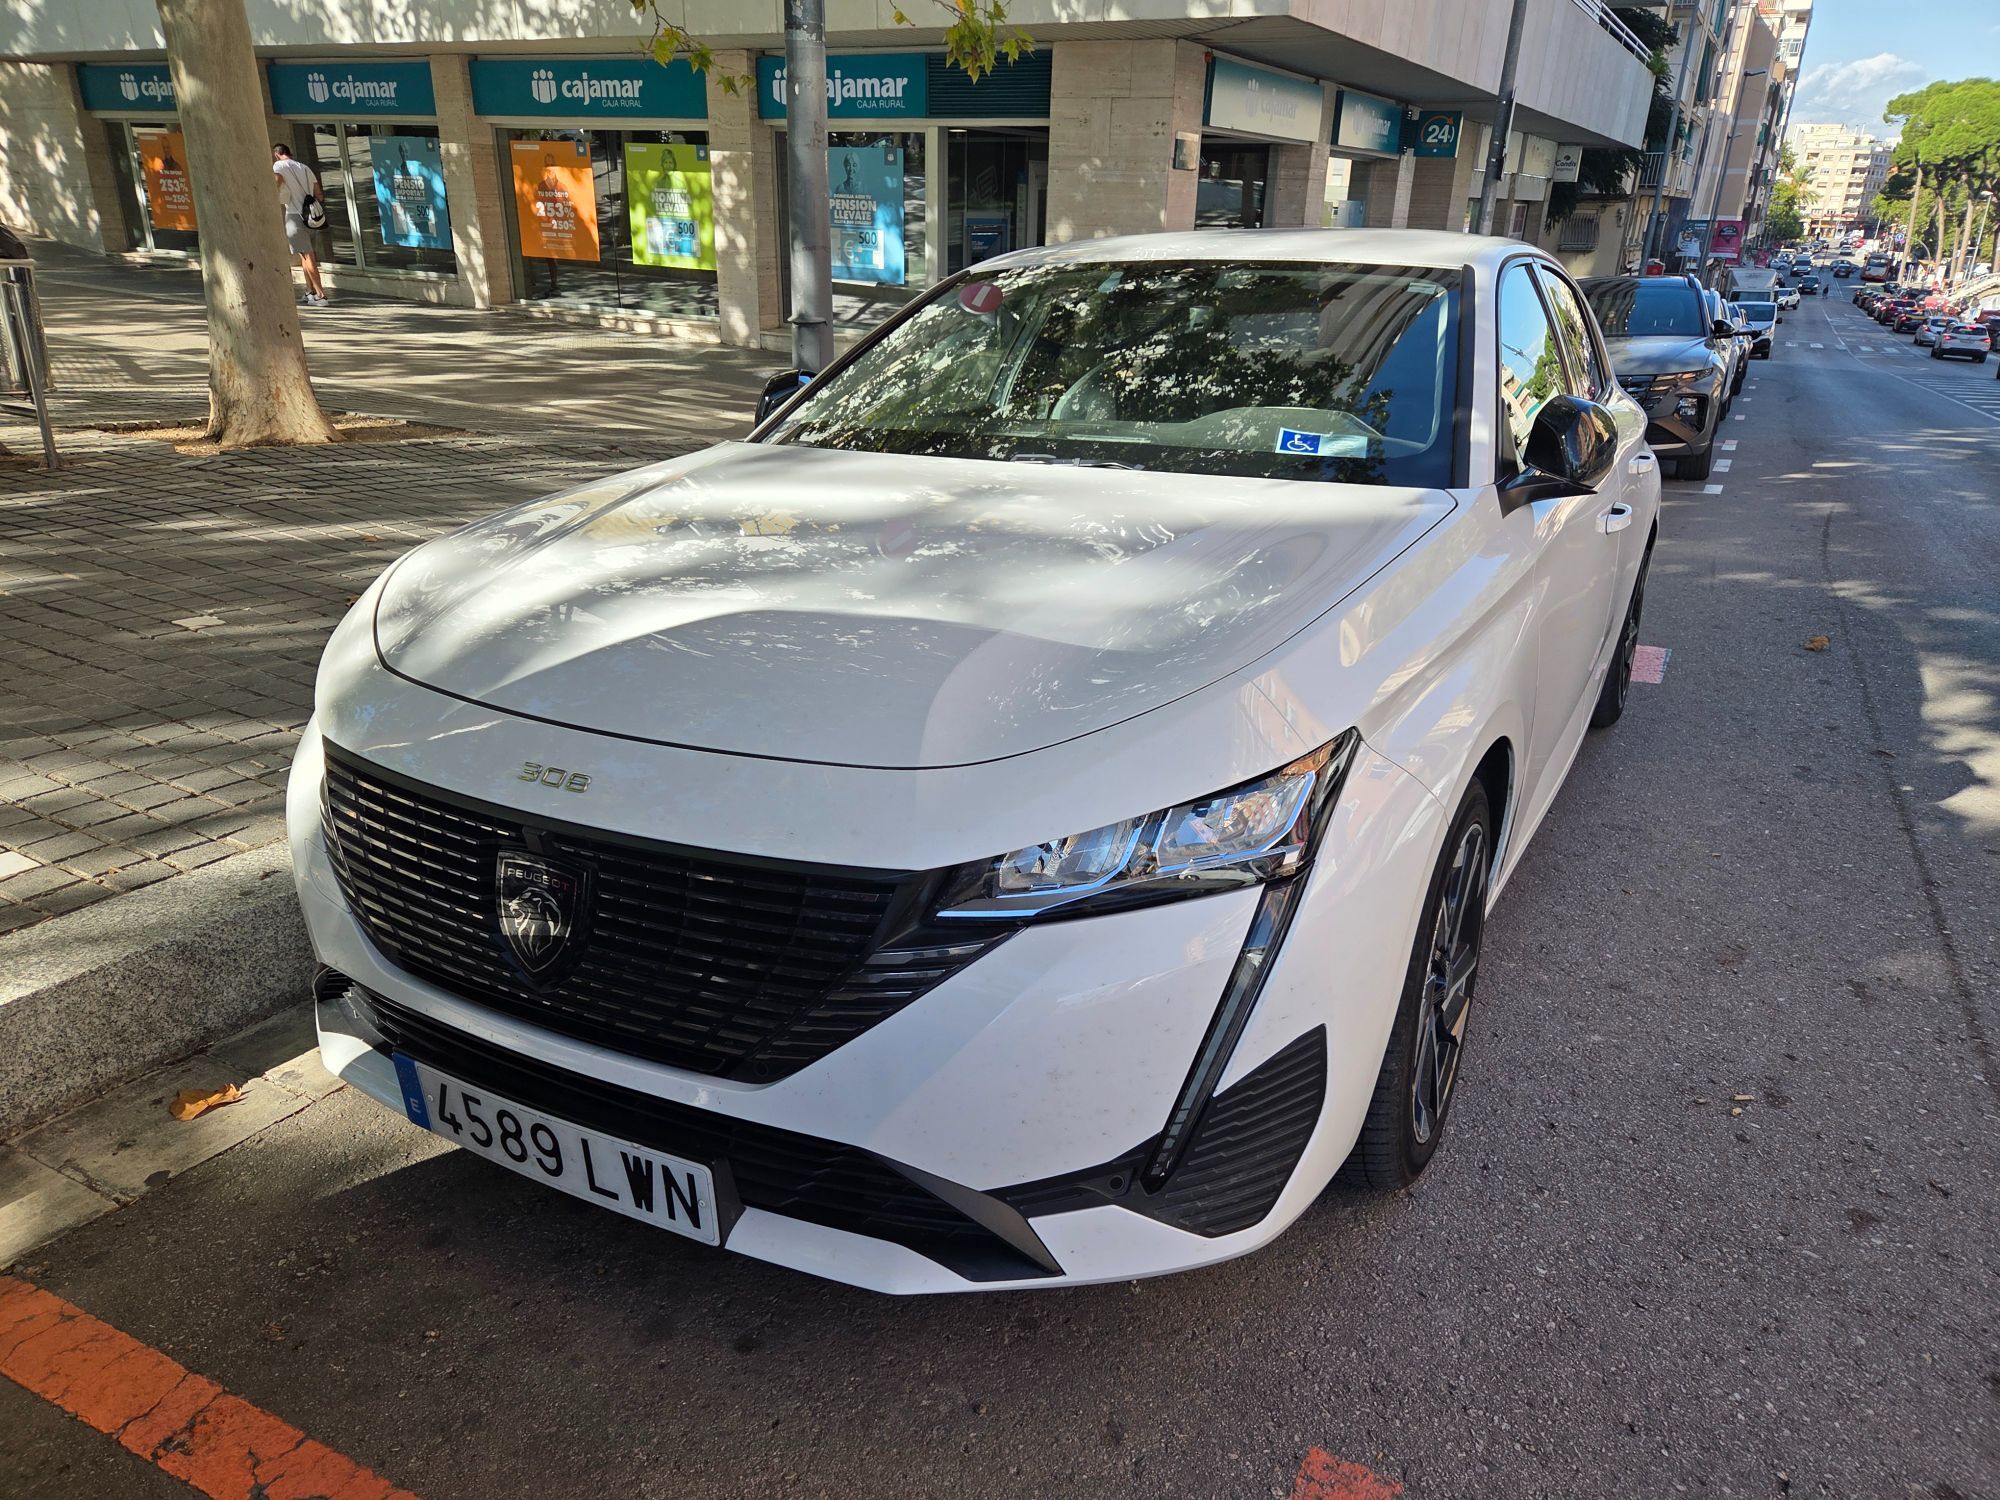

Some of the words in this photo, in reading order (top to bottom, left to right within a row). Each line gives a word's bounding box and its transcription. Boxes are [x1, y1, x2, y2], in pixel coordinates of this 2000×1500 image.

[140, 75, 174, 102] caja
[331, 74, 397, 105] cajamar
[561, 71, 643, 106] cajamar
[825, 69, 908, 106] ajamar
[365, 98, 379, 107] CAJA
[380, 98, 399, 107] RURAL
[601, 99, 619, 108] CAJA
[620, 99, 643, 108] RURAL
[856, 99, 877, 109] CAJA
[879, 99, 906, 109] RURAL
[678, 222, 695, 235] 500
[858, 231, 877, 245] 500
[517, 761, 593, 794] 308
[507, 867, 570, 890] PEUGEOT
[409, 1096, 421, 1113] E
[438, 1083, 564, 1177] 4589
[580, 1138, 702, 1230] LWN
